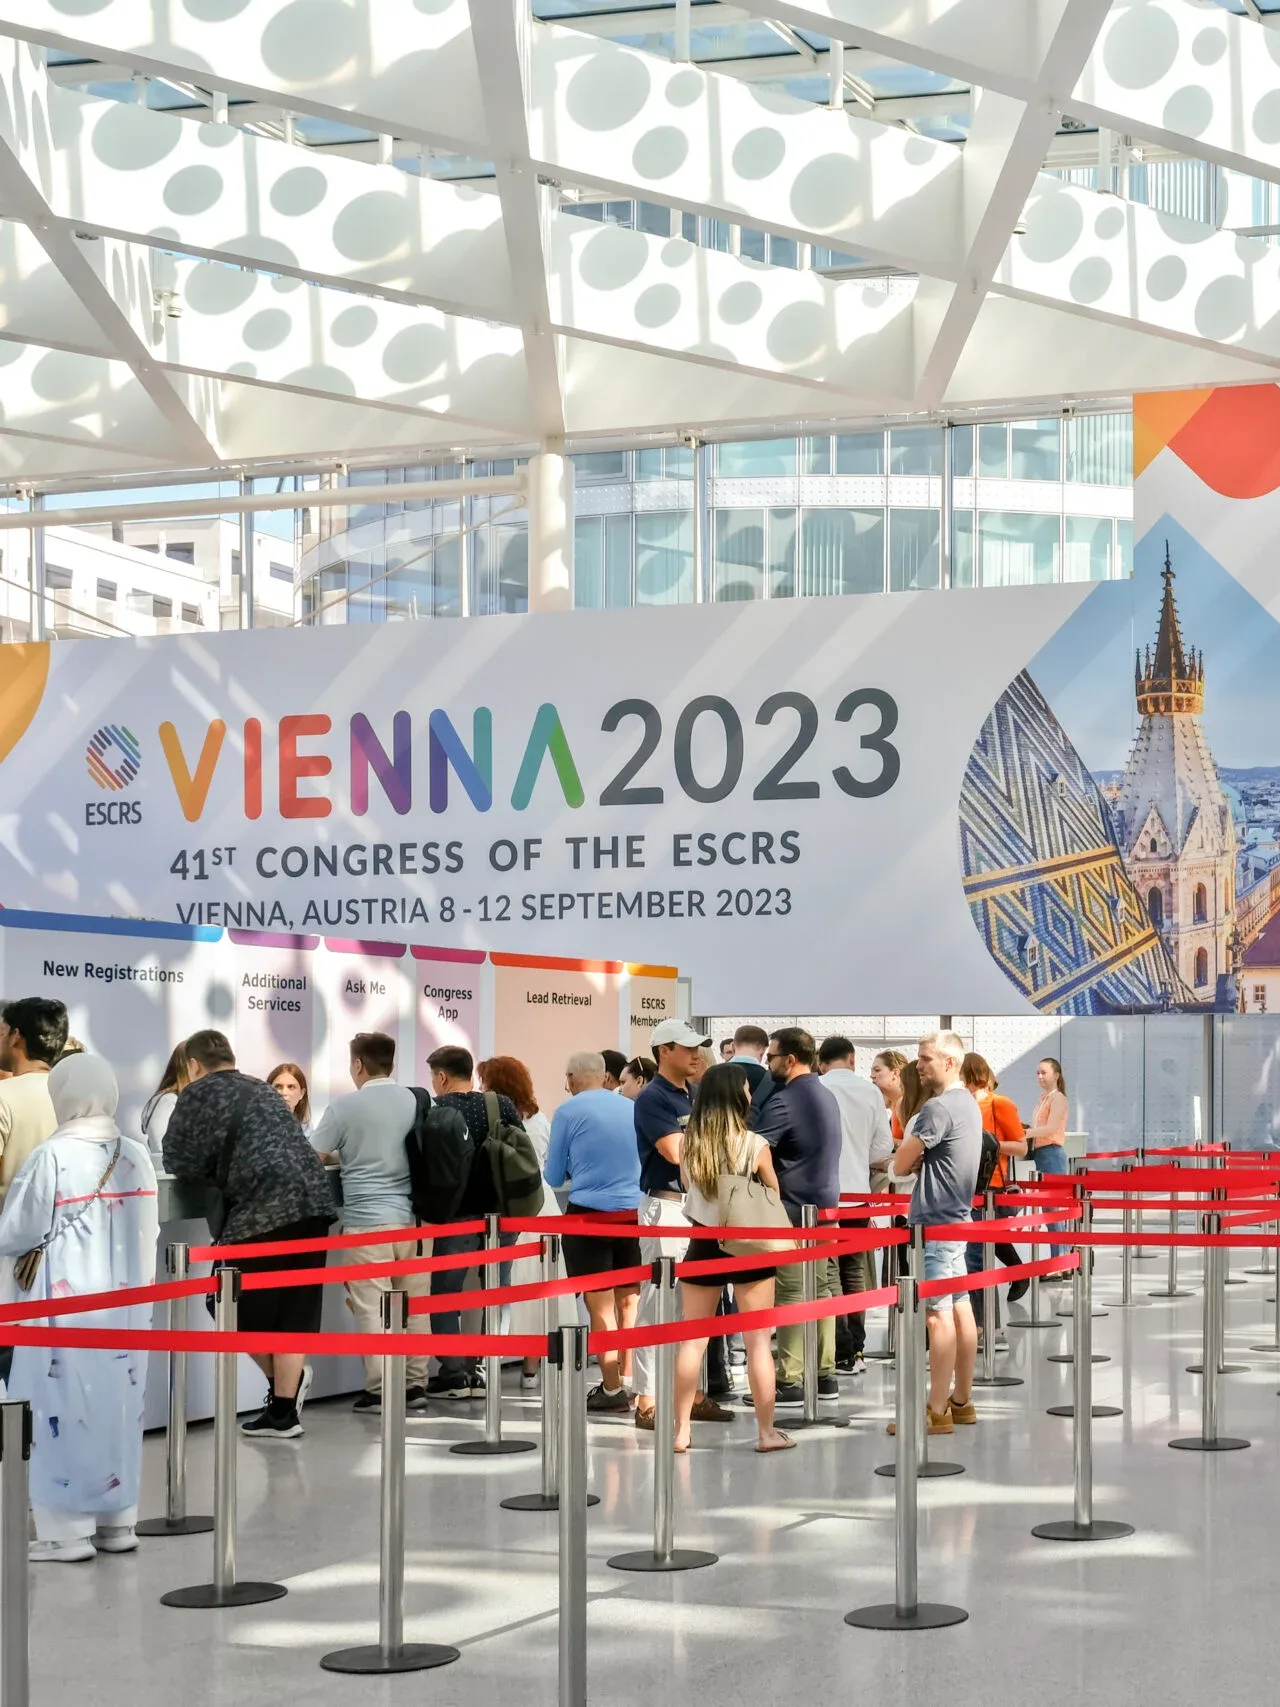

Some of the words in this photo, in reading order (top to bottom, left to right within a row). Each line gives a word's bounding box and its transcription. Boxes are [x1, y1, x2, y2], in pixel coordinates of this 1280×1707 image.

[85, 801, 142, 826] ESCRS
[255, 841, 464, 879] CONGRESS
[488, 838, 542, 872] OF
[565, 835, 646, 869] THE
[673, 830, 801, 867] ESCRS
[176, 900, 294, 930] VIENNA,
[302, 897, 430, 926] AUSTRIA
[521, 890, 706, 921] SEPTEMBER
[716, 887, 792, 916] 2023
[43, 961, 79, 978] New
[84, 963, 184, 984] Registrations
[242, 973, 307, 991] Additional
[345, 980, 367, 994] Ask
[370, 981, 386, 995] Me
[424, 984, 473, 1001] Congress
[526, 991, 549, 1005] Lead
[552, 992, 592, 1006] Retrieval
[248, 996, 301, 1012] Services
[641, 997, 666, 1010] ESCRS
[438, 1006, 459, 1021] App
